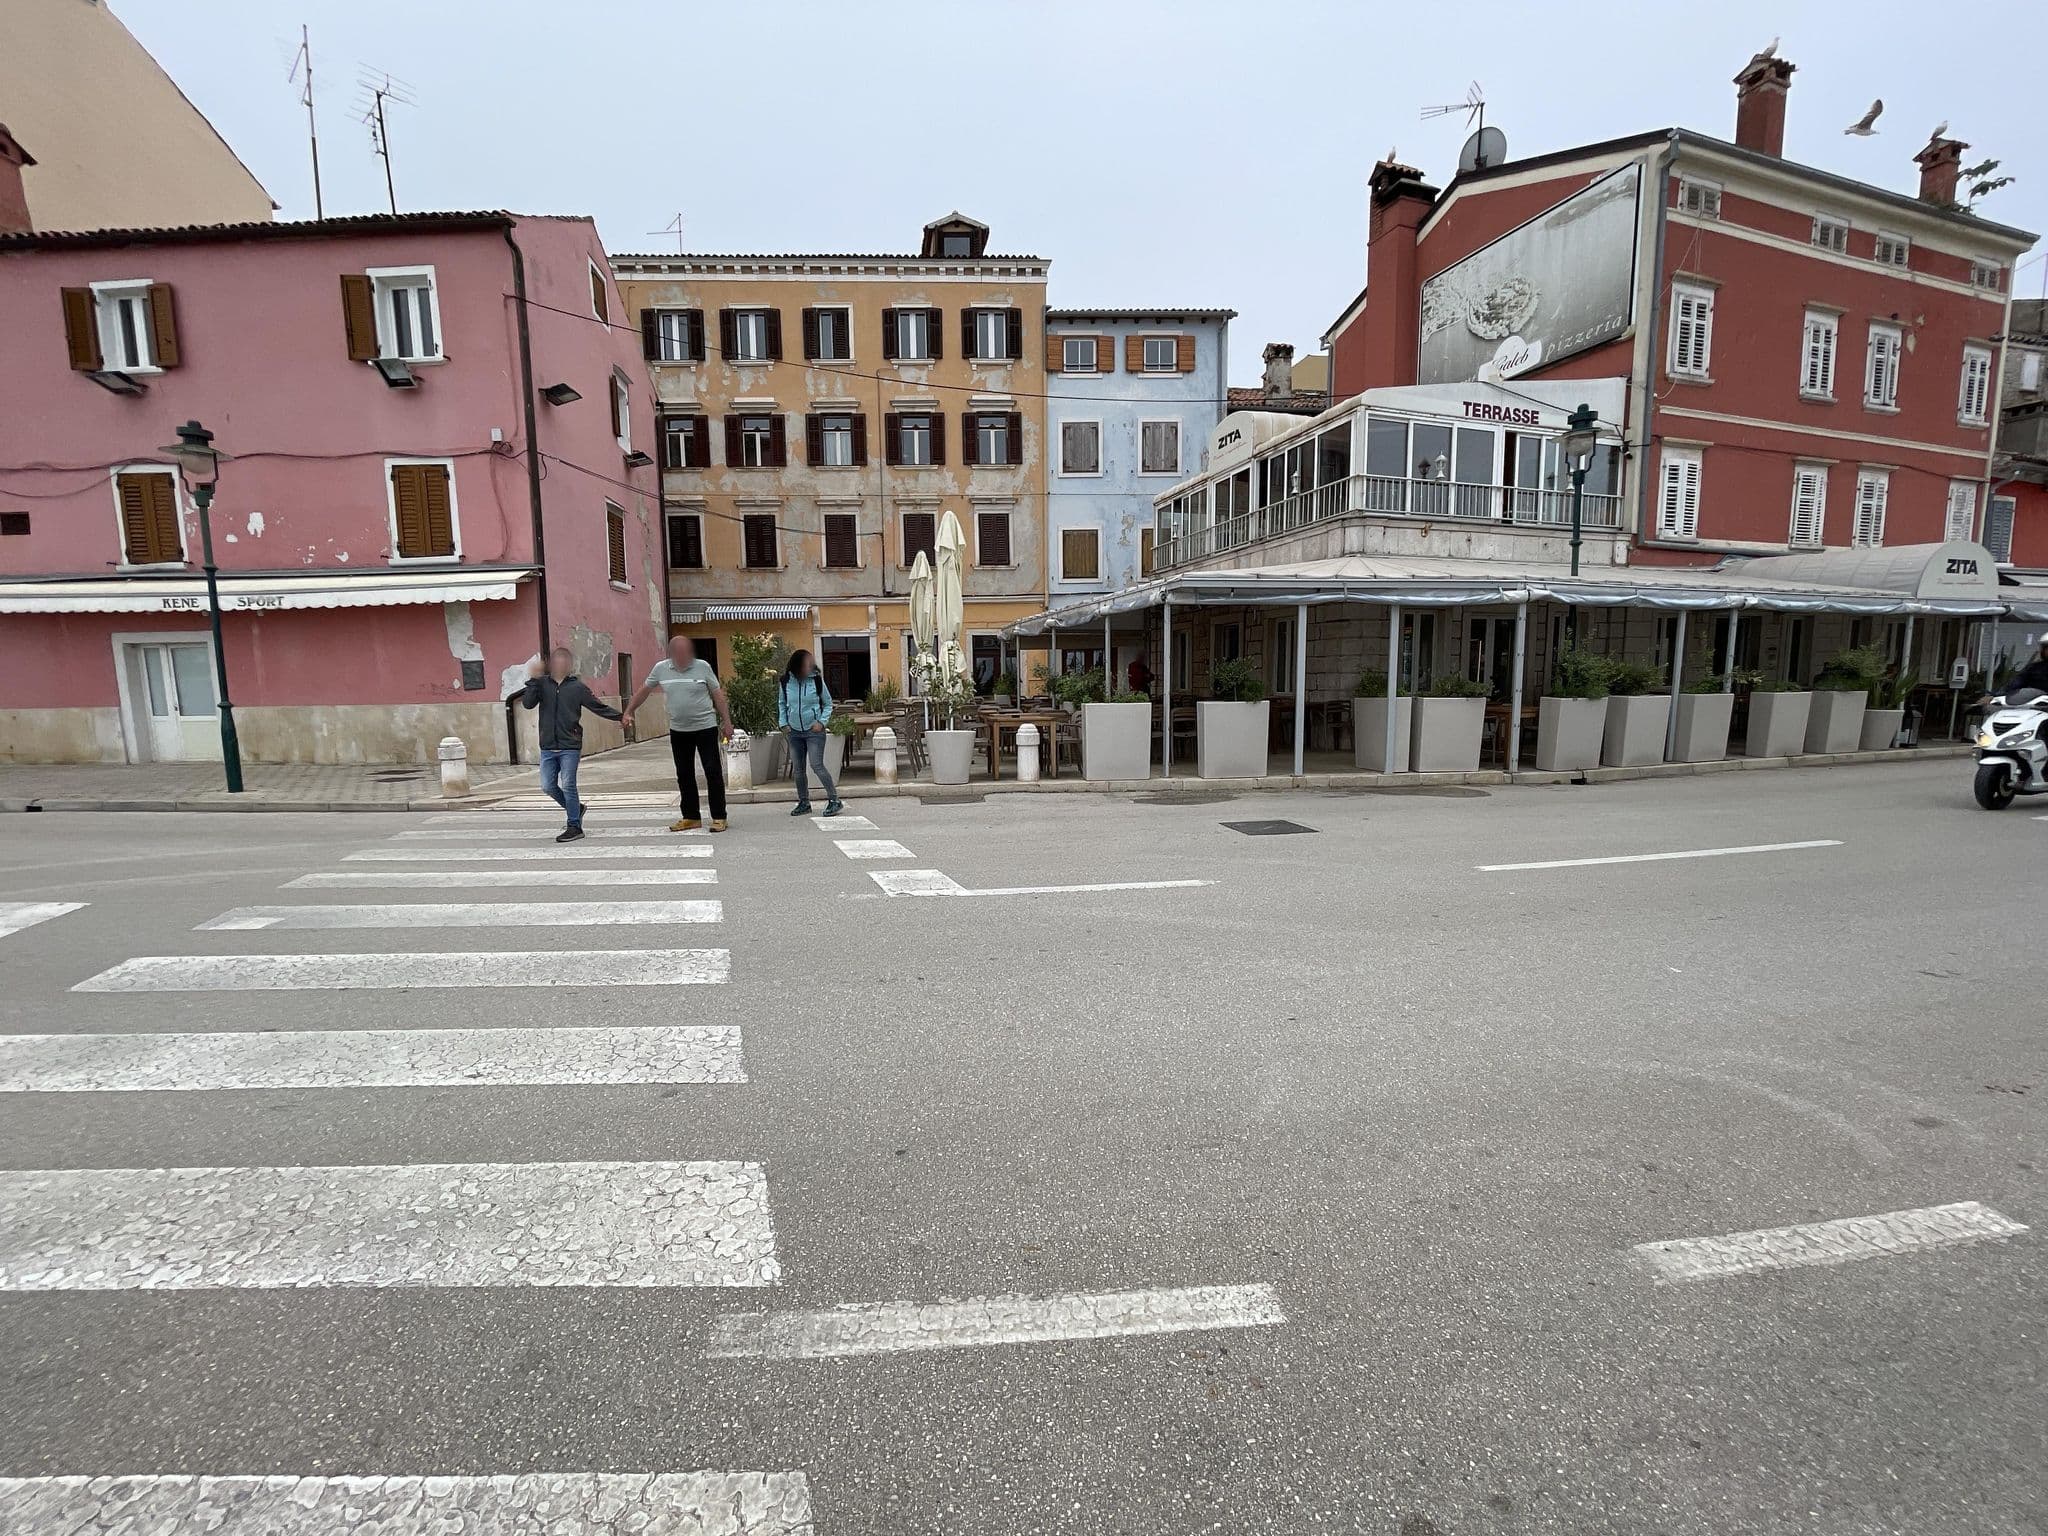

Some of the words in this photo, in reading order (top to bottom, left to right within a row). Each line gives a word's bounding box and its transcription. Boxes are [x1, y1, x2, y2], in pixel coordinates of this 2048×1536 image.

[1544, 315, 1622, 362] pizzeria
[1463, 401, 1540, 425] TERRASSE
[1218, 429, 1241, 449] ZITA
[1946, 558, 1978, 575] ZITA
[162, 598, 200, 609] KENE
[237, 596, 284, 607] SPORT
